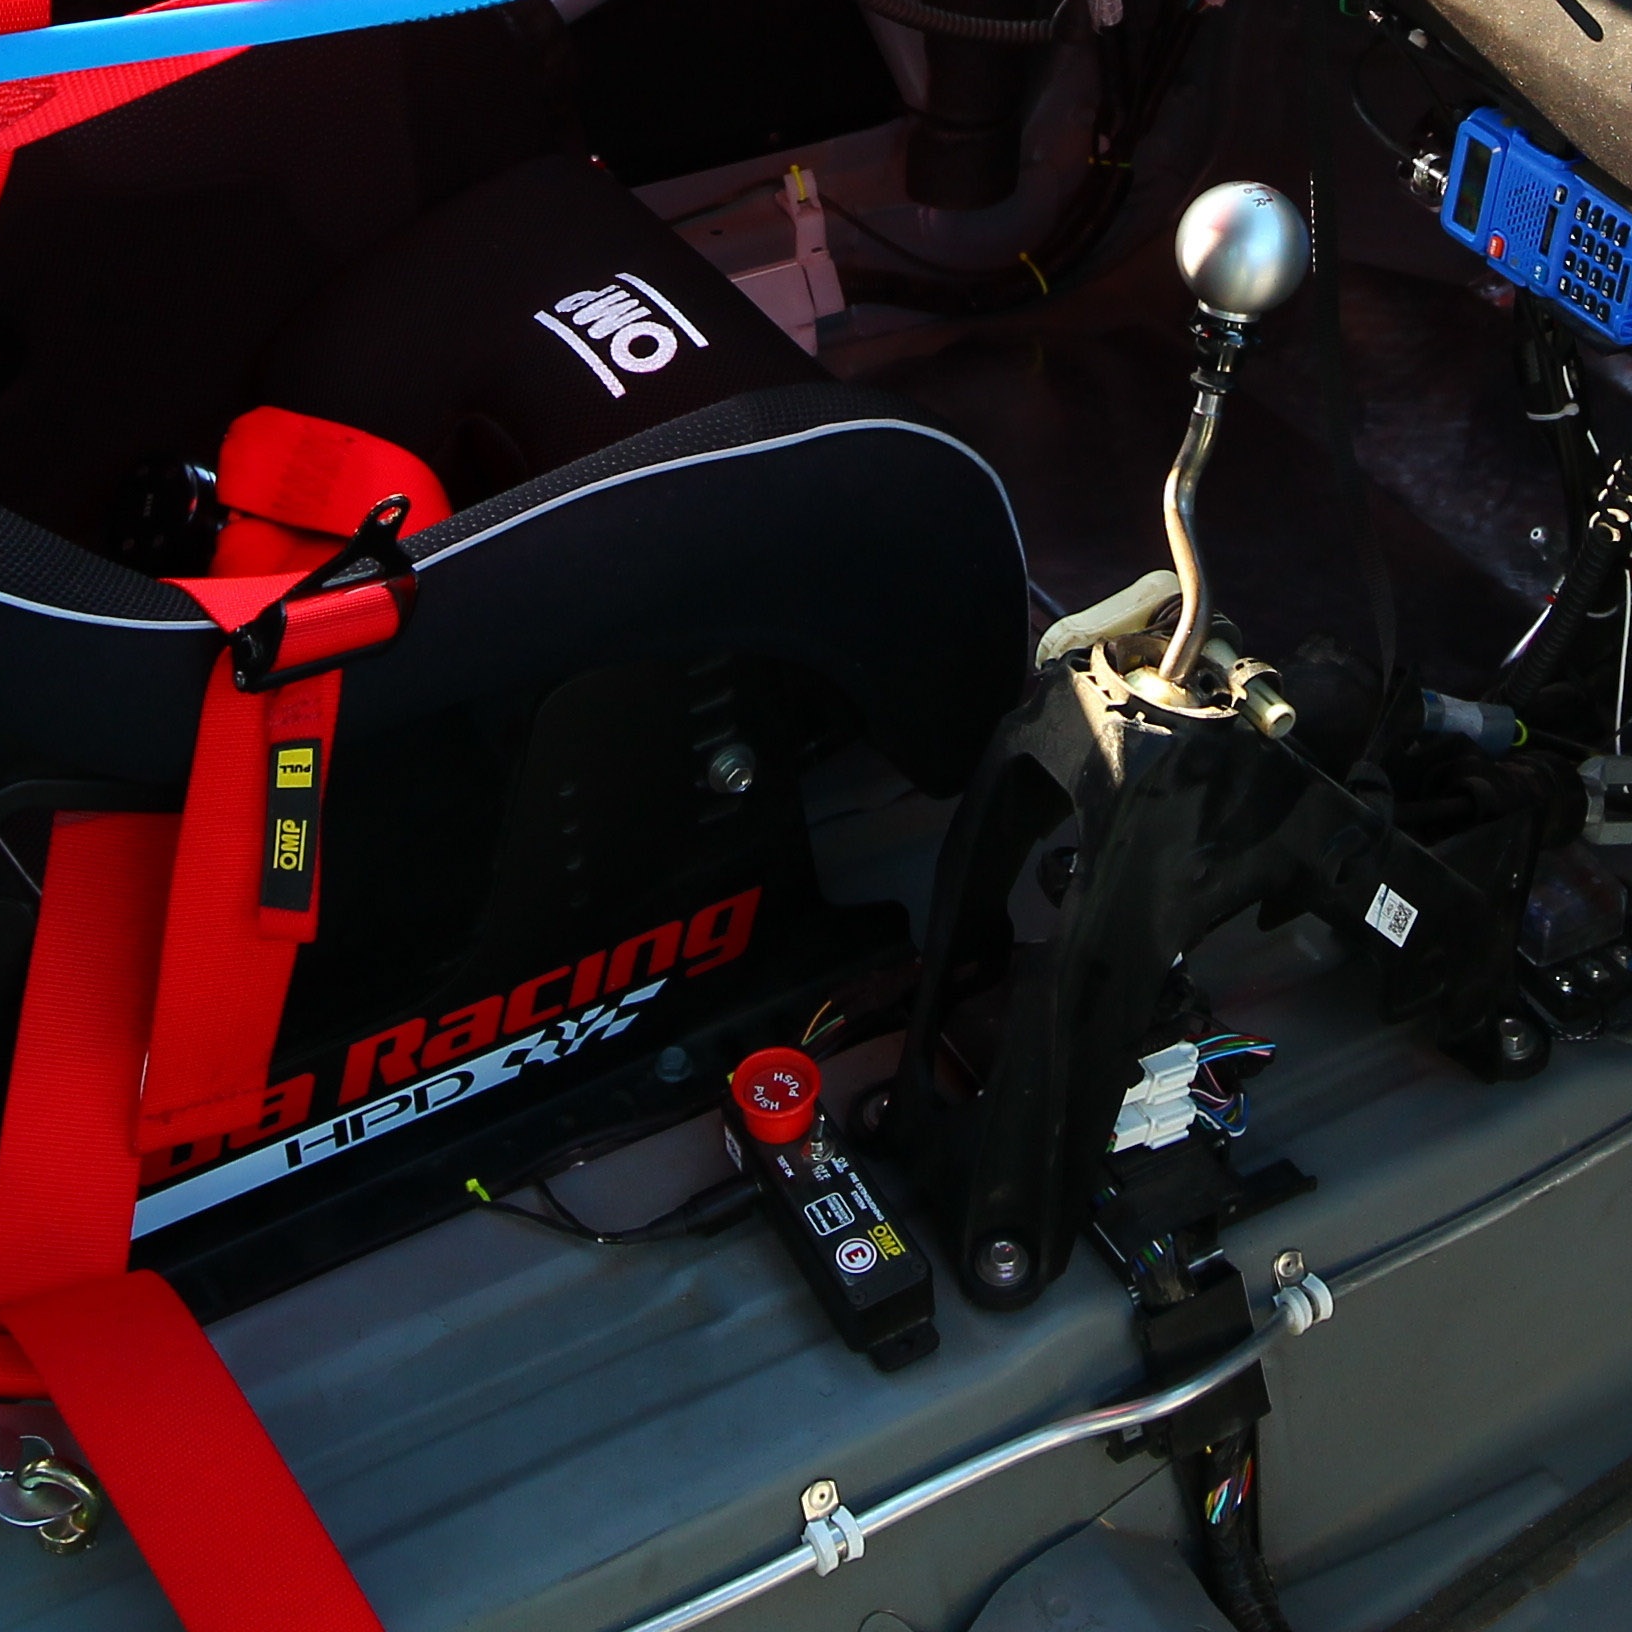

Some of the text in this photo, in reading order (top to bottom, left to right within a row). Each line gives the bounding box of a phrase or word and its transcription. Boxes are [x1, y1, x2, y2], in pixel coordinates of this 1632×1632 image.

[554, 283, 678, 373] OMP
[279, 763, 312, 775] PULL
[279, 819, 301, 870] OMP
[336, 886, 762, 1106] Racing
[753, 1085, 780, 1111] PUSH
[773, 1072, 800, 1098] PUSH
[285, 1070, 476, 1169] HPD
[872, 1225, 902, 1257] OMP
